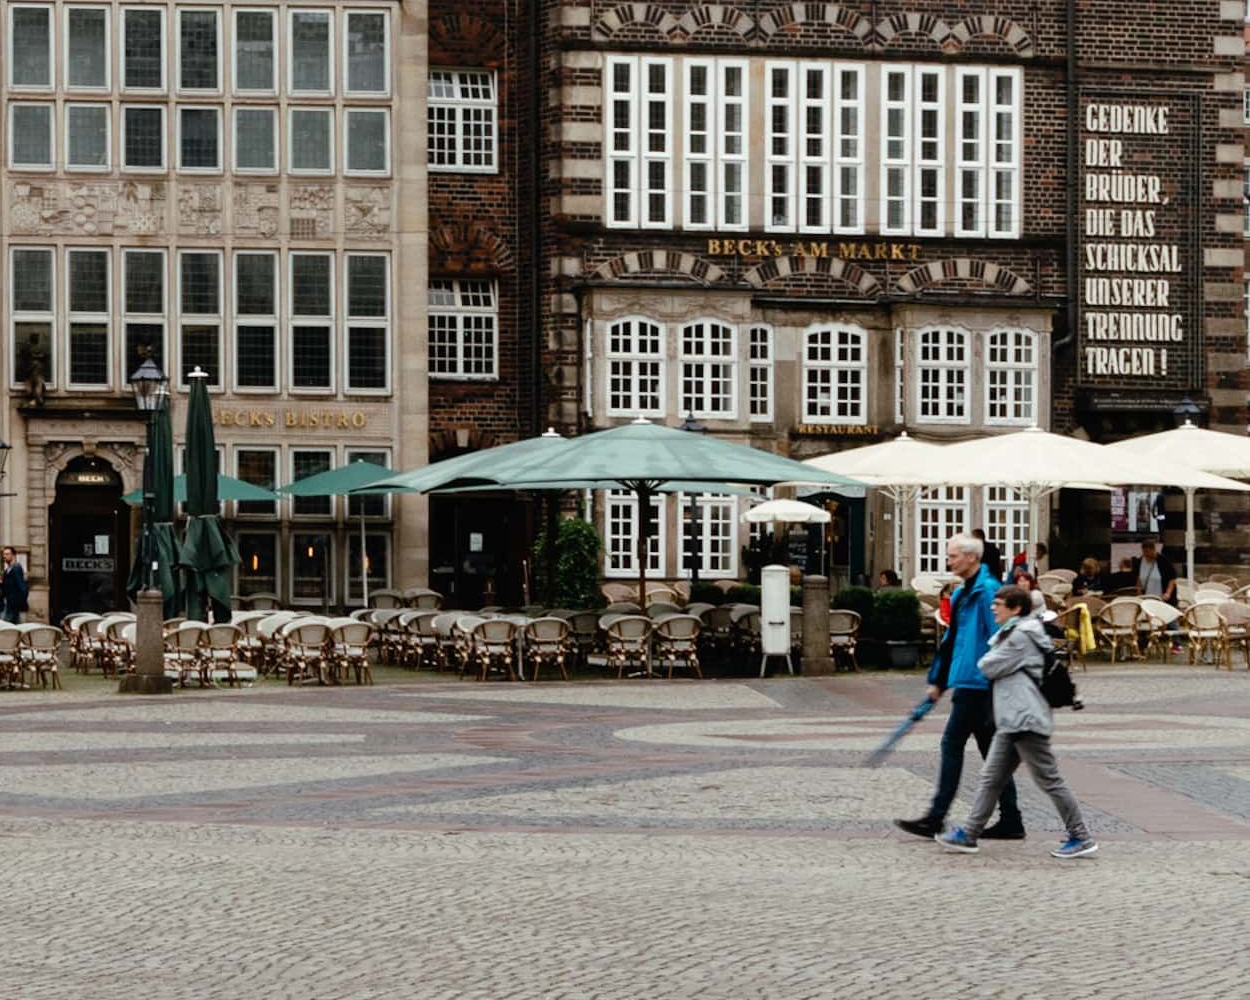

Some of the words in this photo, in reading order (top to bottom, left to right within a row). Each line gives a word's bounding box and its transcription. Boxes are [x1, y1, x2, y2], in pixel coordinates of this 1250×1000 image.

[1085, 103, 1169, 134] GEDENKE
[1085, 138, 1122, 167] DER
[1085, 169, 1169, 205] BRÜDER,
[1085, 208, 1116, 236] DIE
[1121, 209, 1156, 238] DAS
[793, 241, 828, 258] AM
[838, 242, 922, 260] MARKT
[1085, 243, 1183, 273] SCHICKSAL
[1085, 277, 1170, 307] UNSERER
[1085, 312, 1184, 342] TRENNUNG
[1085, 346, 1155, 376] TRAGEN
[285, 406, 368, 429] BISTRO
[797, 423, 879, 435] RESTAURANT
